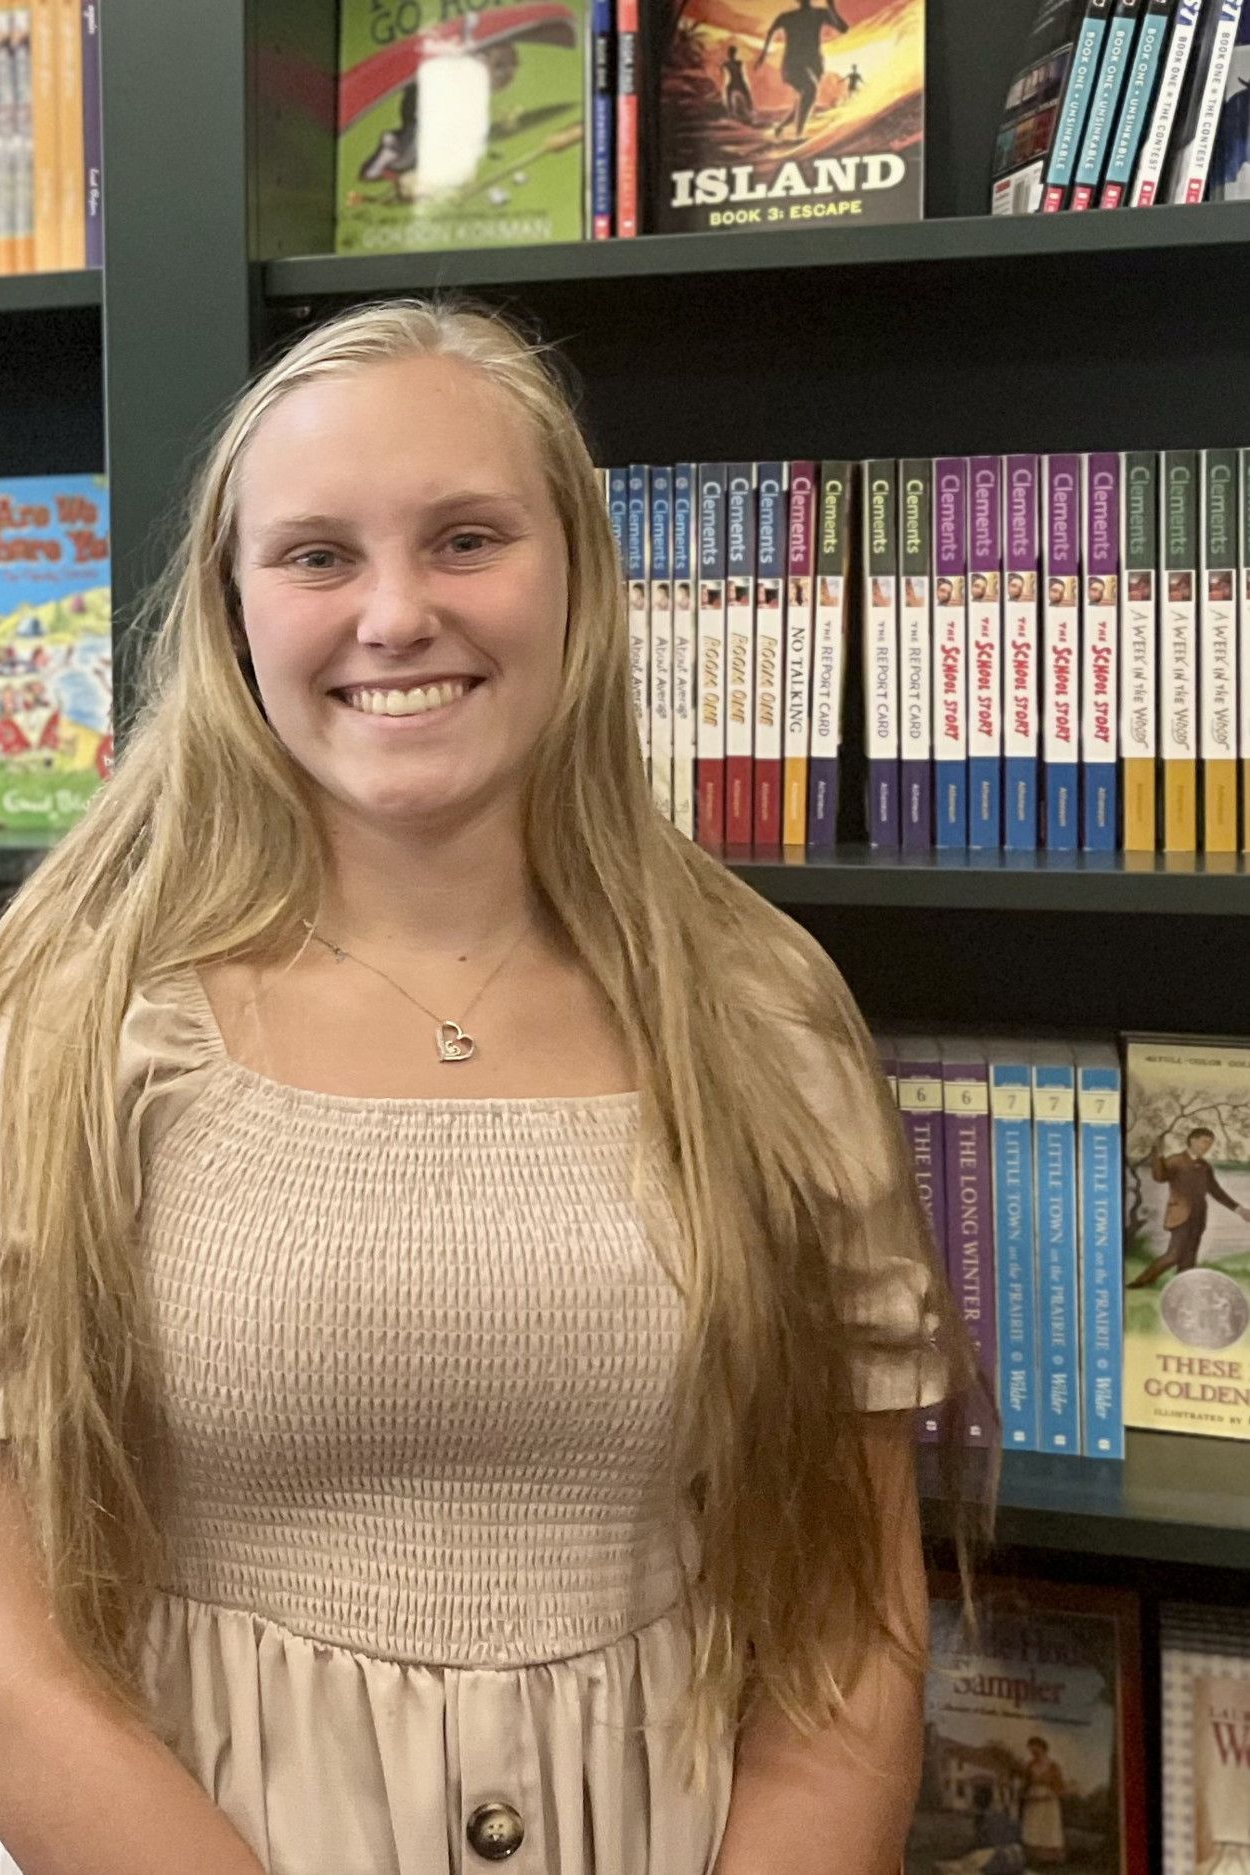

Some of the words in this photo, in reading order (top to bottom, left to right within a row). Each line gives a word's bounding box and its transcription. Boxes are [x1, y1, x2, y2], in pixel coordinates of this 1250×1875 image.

[370, 1, 421, 45] GO
[1110, 30, 1125, 62] BOOK
[1141, 27, 1157, 60] BOOK
[1081, 31, 1096, 63] BOOK
[1174, 35, 1188, 64] BOOK
[1217, 32, 1231, 61] BOOK
[1074, 66, 1087, 90] ONE
[1103, 65, 1117, 90] ONE
[1134, 63, 1148, 87] ONE
[1168, 66, 1181, 87] ONE
[1211, 63, 1224, 84] ONE
[1160, 102, 1172, 121] THE
[1204, 99, 1216, 118] THE
[1056, 101, 1078, 170] UNSINKABLE
[1085, 100, 1109, 170] UNSINKABLE
[1115, 98, 1139, 169] UNSINKABLE
[1148, 125, 1166, 171] CONTEST
[1195, 122, 1214, 169] CONTEST
[671, 153, 906, 208] ISLAND
[709, 208, 761, 227] BOOK
[768, 207, 784, 221] 3:
[789, 200, 863, 219] ESCAPE
[56, 495, 98, 526] We
[703, 481, 721, 566] Clements
[730, 477, 749, 562] Clements
[760, 479, 779, 564] Clements
[792, 477, 811, 562] Clements
[823, 480, 842, 554] Clements
[872, 480, 889, 553] Clements
[906, 480, 924, 554] Clements
[941, 475, 960, 561] Clements
[975, 470, 995, 557] Clements
[1012, 469, 1032, 556] Clements
[1053, 473, 1073, 561] Clements
[1093, 472, 1113, 560] Clements
[1130, 466, 1149, 555] Clements
[1170, 466, 1190, 555] Clements
[1211, 464, 1231, 555] Clements
[629, 499, 644, 570] Clements
[654, 499, 669, 570] Clements
[675, 498, 690, 570] Clements
[1130, 609, 1148, 621] A
[1171, 609, 1189, 621] A
[1212, 609, 1230, 621] A
[791, 627, 805, 651] NO
[1133, 625, 1149, 666] WEEK
[1174, 625, 1189, 667] WEEK
[1214, 625, 1230, 667] WEEK
[819, 646, 833, 699] REPORT
[877, 647, 889, 700] REPORT
[909, 647, 922, 700] REPORT
[940, 645, 960, 694] SCHOOL
[975, 641, 994, 690] SCHOOL
[1012, 641, 1031, 690] SCHOOL
[1052, 645, 1072, 696] SCHOOL
[1091, 645, 1112, 695] SCHOOL
[790, 658, 804, 734] TALKING
[977, 696, 993, 737] STORY
[1014, 696, 1030, 737] STORY
[817, 703, 831, 737] CARD
[877, 703, 889, 738] CARD
[909, 704, 922, 739] CARD
[944, 700, 959, 741] STORY
[1055, 701, 1070, 743] STORY
[1094, 701, 1109, 743] STORY
[916, 1087, 926, 1102] 6
[961, 1089, 971, 1105] 6
[1007, 1095, 1017, 1110] 7
[1048, 1097, 1059, 1112] 7
[1094, 1100, 1105, 1114] 7
[915, 1123, 933, 1164] THE
[959, 1126, 977, 1168] THE
[1006, 1130, 1022, 1187] LITTLE
[1047, 1132, 1064, 1189] LITTLE
[1093, 1135, 1109, 1192] LITTLE
[960, 1174, 979, 1235] LONG
[1007, 1192, 1022, 1240] TOWN
[1049, 1195, 1065, 1243] TOWN
[1094, 1200, 1110, 1246] TOWN
[962, 1241, 981, 1321] WINTER
[1009, 1282, 1024, 1343] PRAIRIE
[1051, 1285, 1066, 1346] PRAIRIE
[1096, 1289, 1110, 1351] PRAIRIE
[1155, 1354, 1243, 1380] THESE
[1008, 1369, 1026, 1412] Wilder
[1050, 1372, 1068, 1416] Wilder
[1095, 1376, 1113, 1419] Wilder
[1144, 1378, 1250, 1407] GOLDEN
[1153, 1408, 1225, 1423] ILLUSTRATED
[952, 1658, 1066, 1709] Sampler
